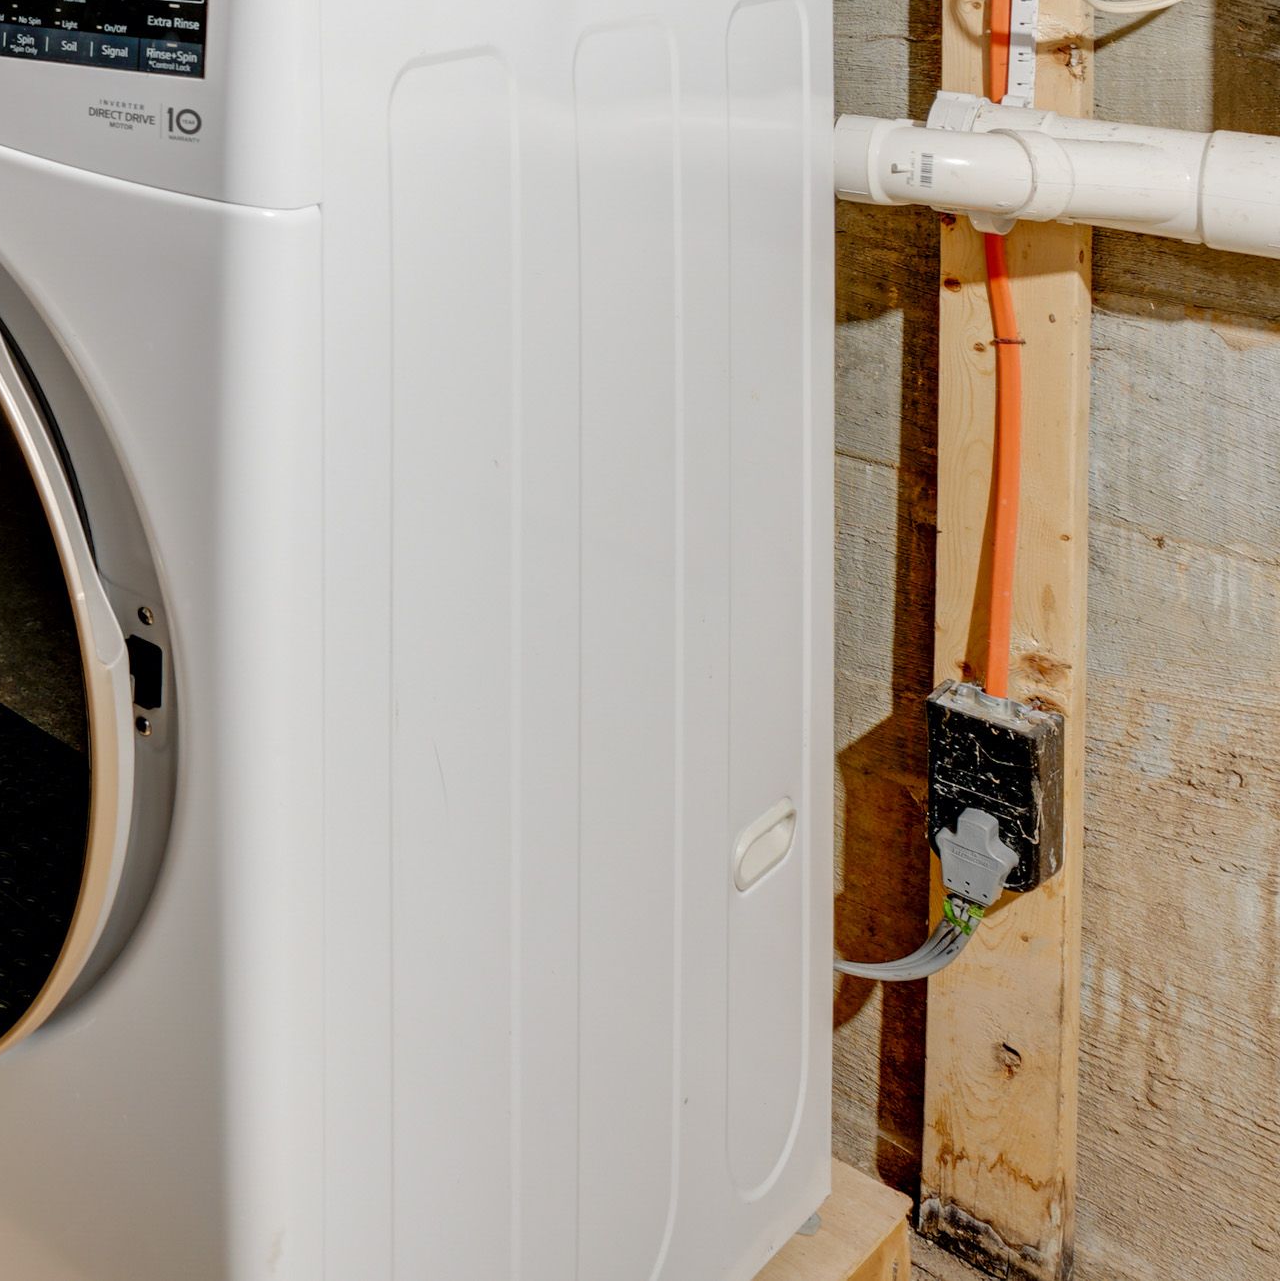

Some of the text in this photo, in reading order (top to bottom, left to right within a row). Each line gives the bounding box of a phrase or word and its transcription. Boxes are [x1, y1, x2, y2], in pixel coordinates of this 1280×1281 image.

[18, 16, 41, 26] No Spin
[62, 20, 78, 30] Light
[147, 15, 200, 30] Extra Rinse
[104, 24, 127, 34] On/Off
[17, 34, 35, 45] Spin
[25, 47, 38, 55] Only
[61, 40, 78, 52] Soil
[101, 45, 128, 58] Signal
[146, 48, 197, 64] Rinse+Spin
[176, 62, 191, 71] Lock
[99, 99, 145, 111] INVERTER
[88, 106, 156, 125] DIRECT DRIVE
[168, 107, 202, 135] 10
[109, 122, 133, 130] MOTOR
